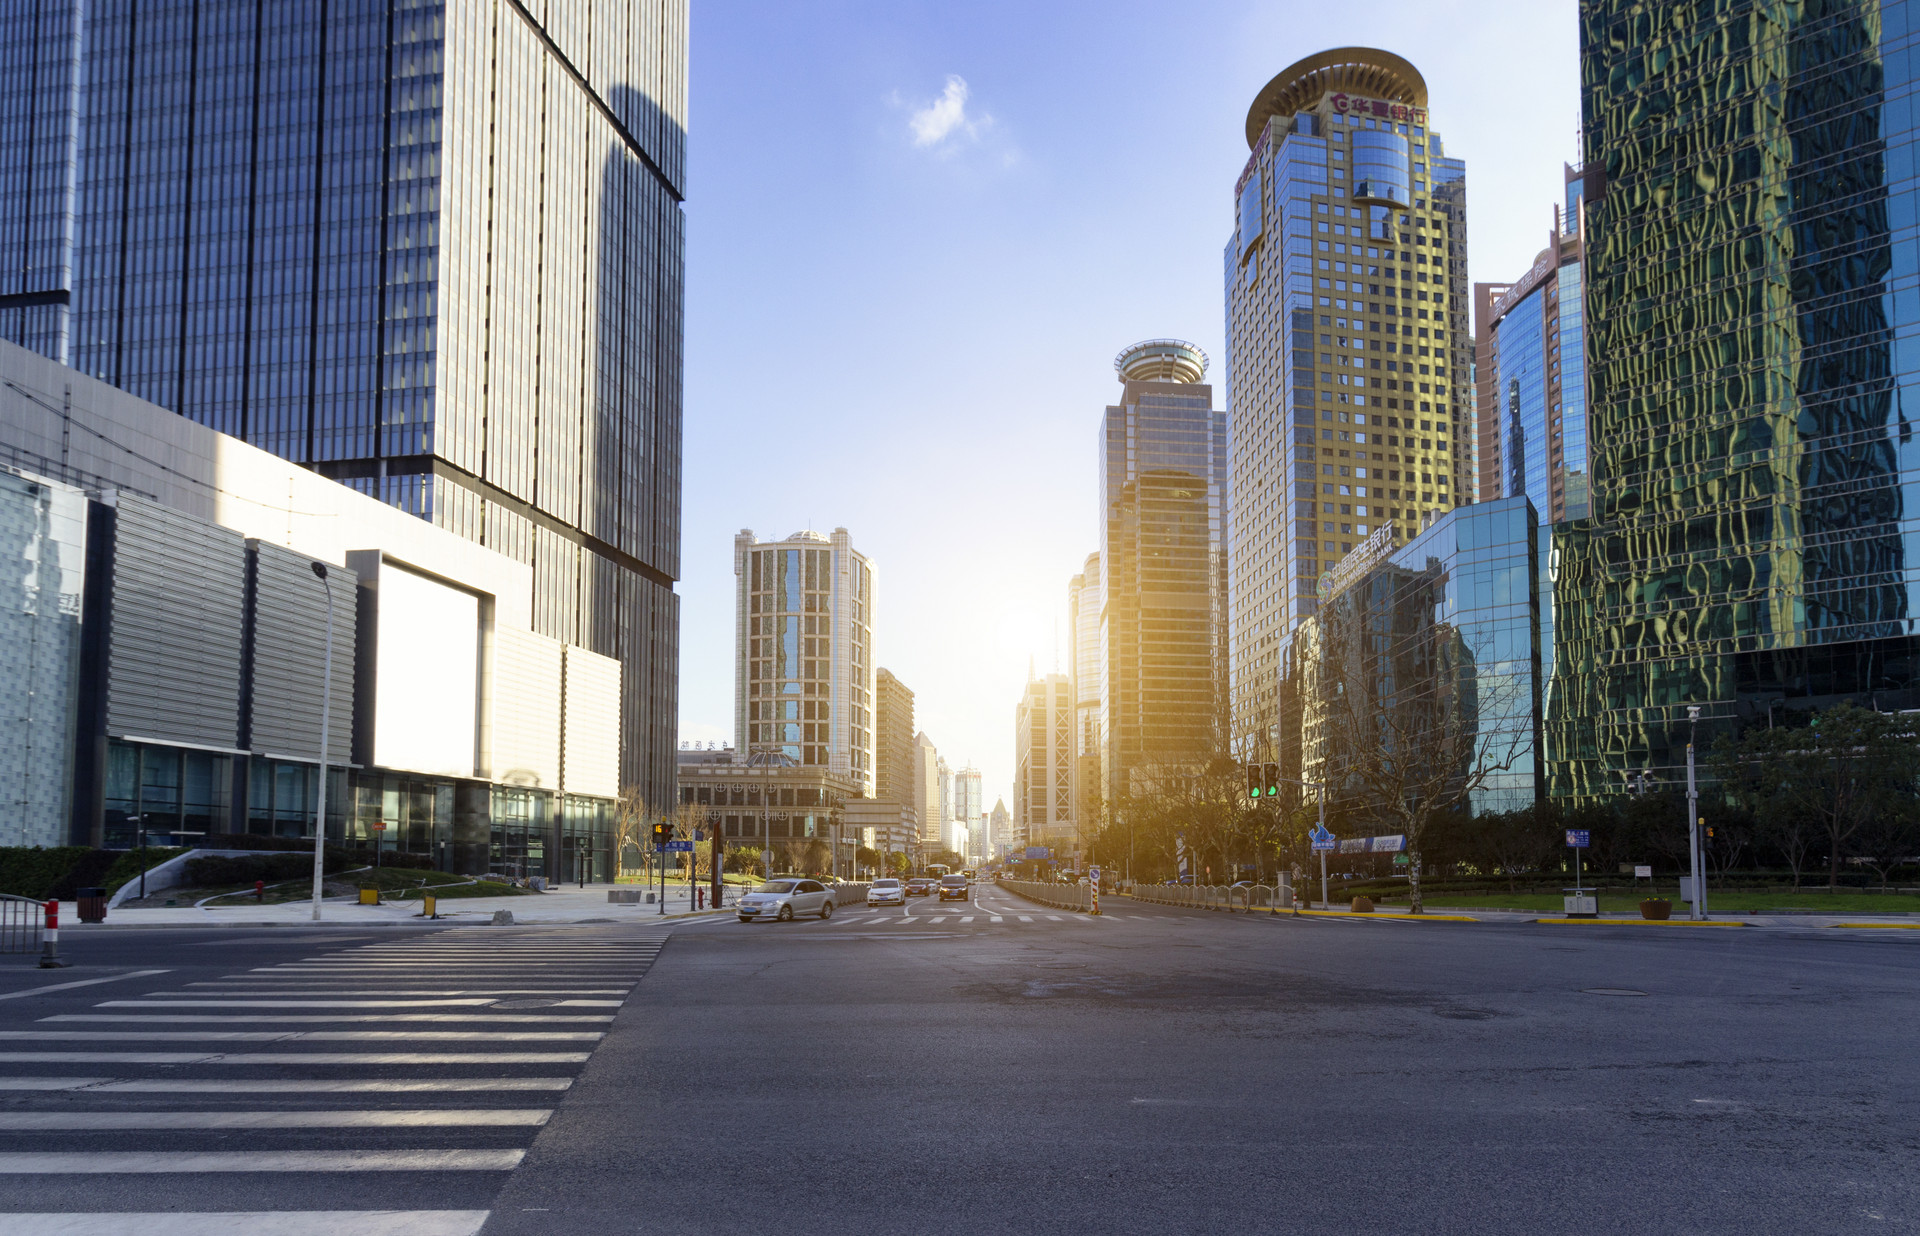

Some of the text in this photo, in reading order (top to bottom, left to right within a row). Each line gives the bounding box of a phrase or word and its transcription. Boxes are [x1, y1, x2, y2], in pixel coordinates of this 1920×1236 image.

[1332, 519, 1393, 580] 中国民生银行
[655, 824, 663, 834] 16
